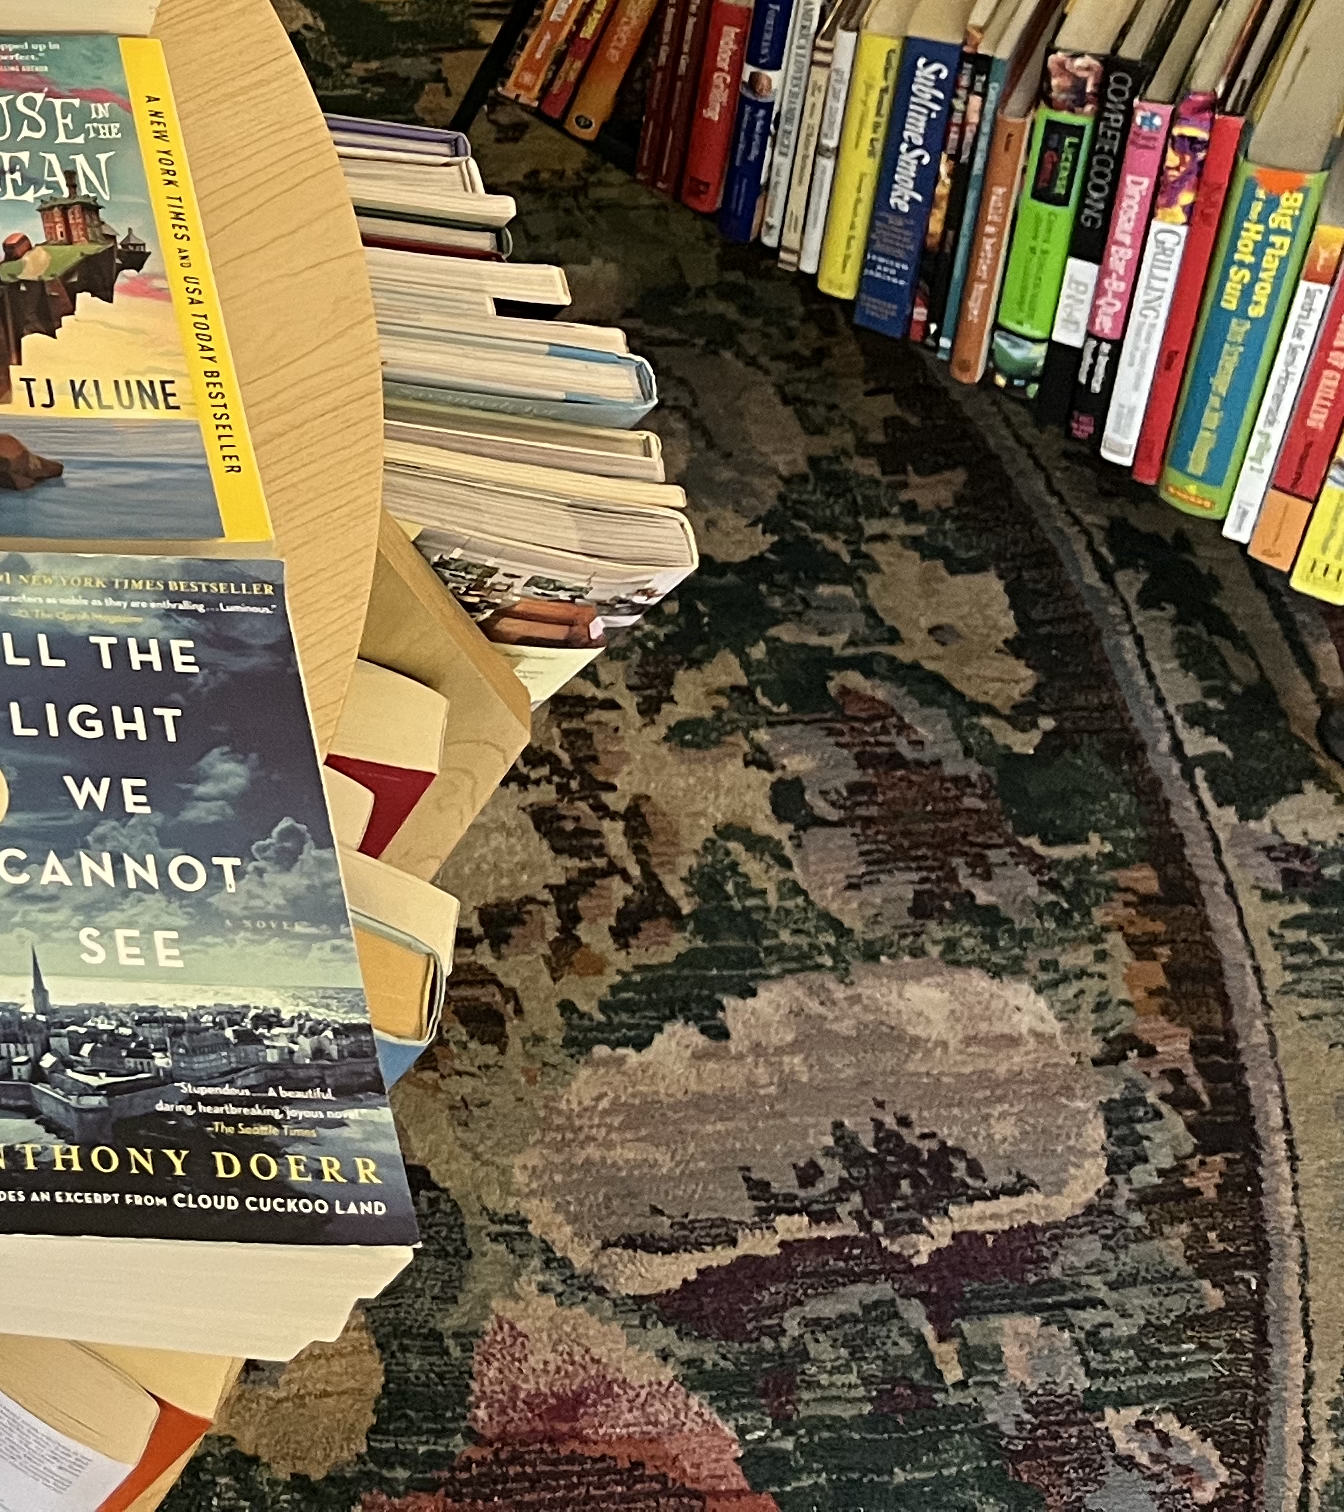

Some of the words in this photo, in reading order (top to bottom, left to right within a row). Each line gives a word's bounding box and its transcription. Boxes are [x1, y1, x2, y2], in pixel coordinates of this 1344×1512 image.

[91, 102, 110, 119] IN
[902, 55, 949, 146] Sublime
[85, 122, 122, 140] THE
[888, 141, 931, 213] Smoke
[19, 377, 55, 409] TJ
[72, 378, 181, 411] KLUNE
[89, 636, 200, 674] THE
[9, 701, 183, 744] LIGHT
[62, 775, 152, 815] WE
[79, 926, 185, 968] SEE
[215, 1150, 383, 1185] DOERR
